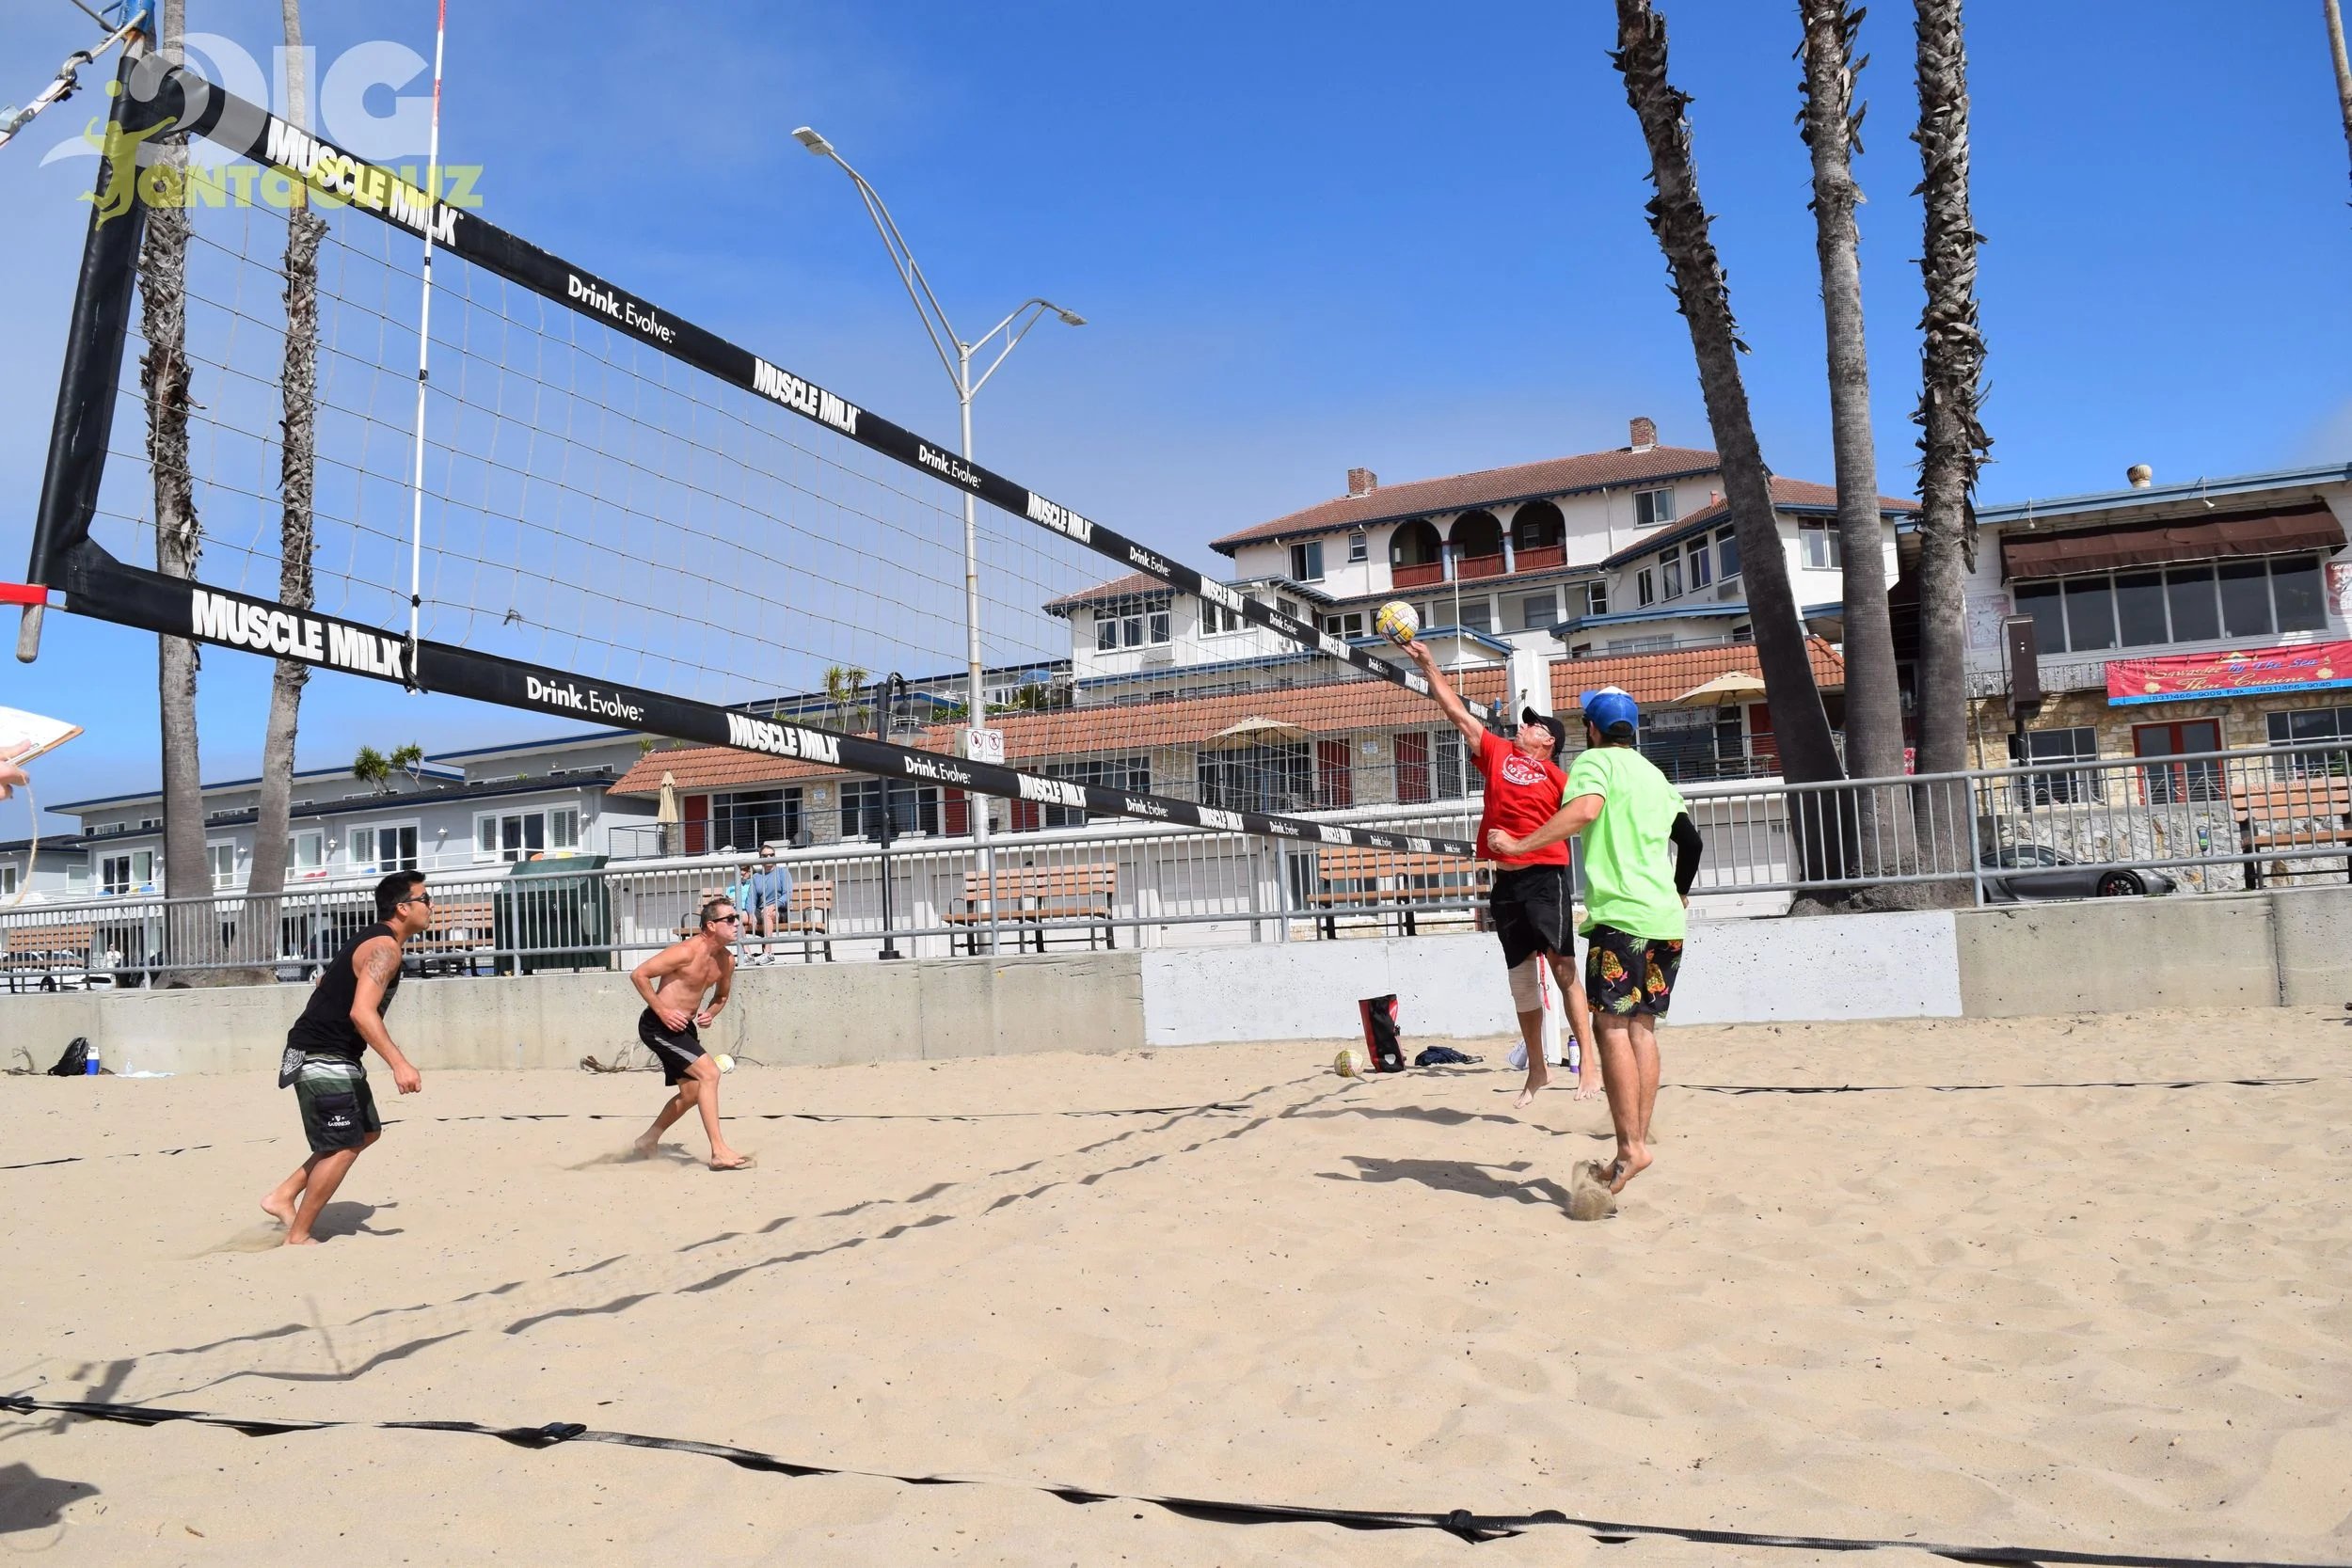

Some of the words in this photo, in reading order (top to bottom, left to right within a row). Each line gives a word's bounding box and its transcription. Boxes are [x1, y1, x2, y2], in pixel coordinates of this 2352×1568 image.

[265, 117, 387, 212] MUSCLE
[389, 177, 458, 246] MILK
[568, 275, 623, 320] Drink.
[754, 357, 818, 416] MUSCLE
[818, 388, 857, 435] MILK
[918, 444, 950, 475] Drink.
[1026, 491, 1067, 532] MUSCLE
[1066, 511, 1091, 545] MILK
[1130, 546, 1151, 569] Drink.
[1200, 575, 1228, 607] MUSCLE
[1227, 588, 1244, 613] MILK
[192, 589, 324, 661] MUSCLE
[328, 622, 404, 679] MILK
[1319, 631, 1339, 656] MUSCLE
[1338, 640, 1351, 661] MILK
[526, 676, 587, 711] Drink.
[2171, 676, 2222, 691] Thai
[2228, 673, 2306, 687] Cuisine
[726, 712, 798, 757] MUSCLE
[798, 727, 840, 765] MILK
[904, 755, 939, 779] Drink.
[1017, 773, 1062, 802] MUSCLE
[1060, 782, 1087, 808] MILK
[1126, 798, 1148, 815] Drink.
[1197, 805, 1227, 830] MUSCLE
[1225, 811, 1244, 832] MILK
[1318, 824, 1340, 844] MUSCLE
